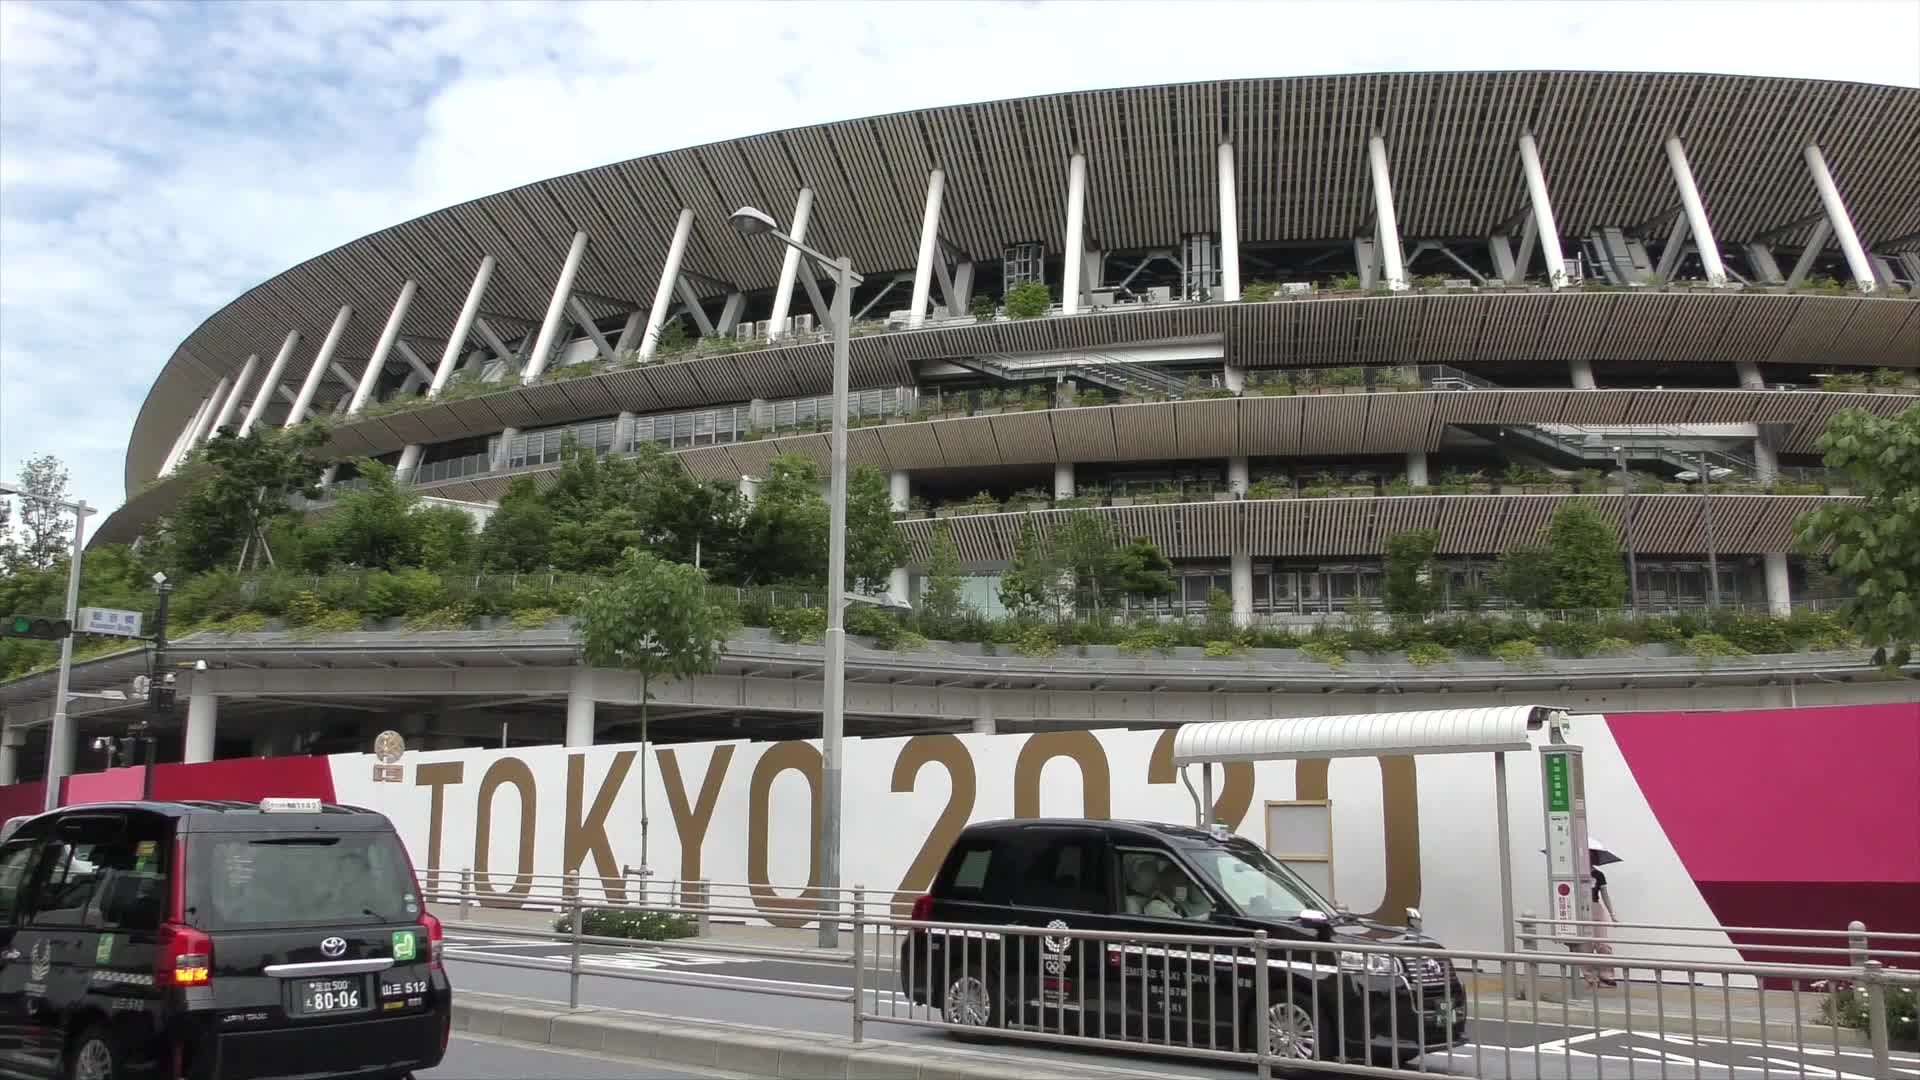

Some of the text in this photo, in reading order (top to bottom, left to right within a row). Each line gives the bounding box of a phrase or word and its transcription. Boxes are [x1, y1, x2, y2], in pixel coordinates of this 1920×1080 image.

[416, 740, 828, 928] TOKYO
[1159, 969, 1181, 981] TXI
[1182, 971, 1216, 984] TOKY
[405, 981, 427, 994] 512
[314, 990, 358, 1010] 80-06
[1157, 1001, 1182, 1013] TXI
